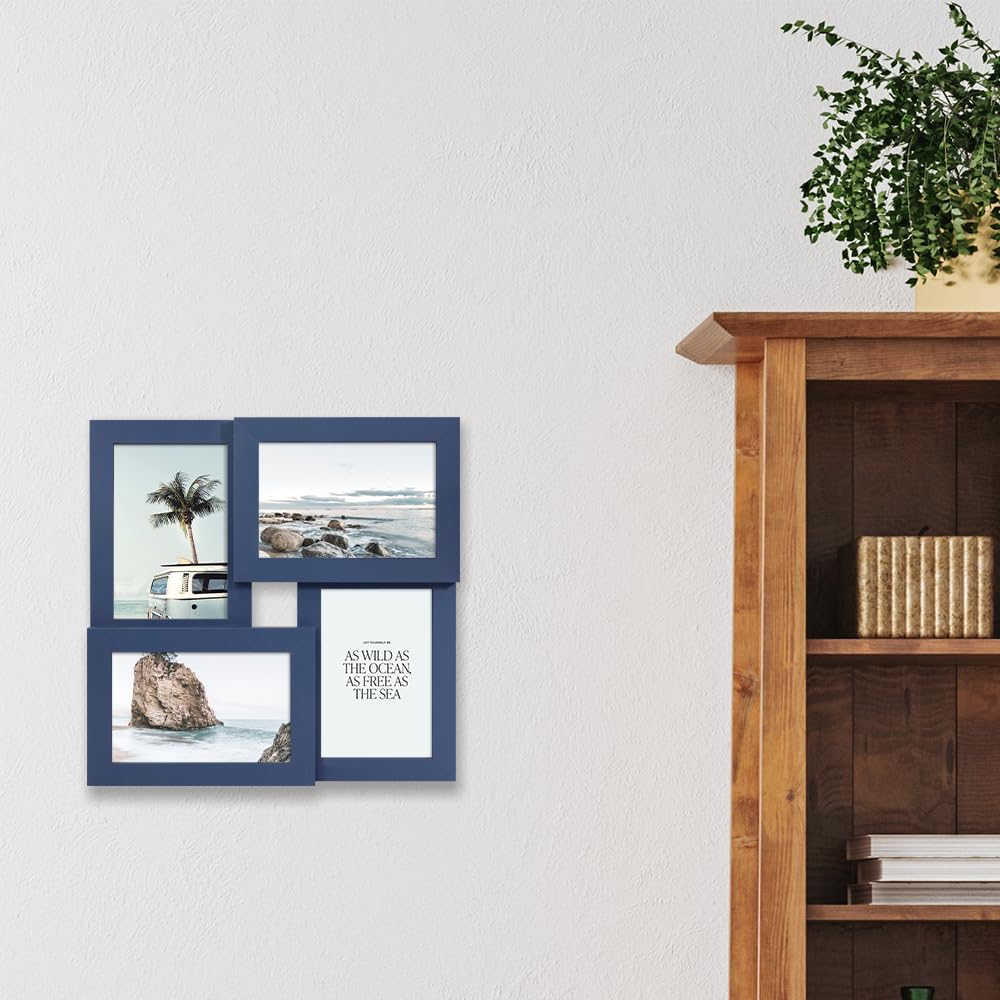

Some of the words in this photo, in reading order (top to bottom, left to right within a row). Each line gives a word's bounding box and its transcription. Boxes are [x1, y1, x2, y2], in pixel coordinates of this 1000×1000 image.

[344, 649, 360, 661] AS
[361, 649, 393, 661] WILD
[395, 649, 410, 661] AS
[342, 662, 367, 674] THE
[345, 675, 361, 687] AS
[362, 675, 392, 687] FREE
[394, 675, 409, 687] AS
[352, 687, 377, 700] THE
[379, 687, 402, 700] SEA
